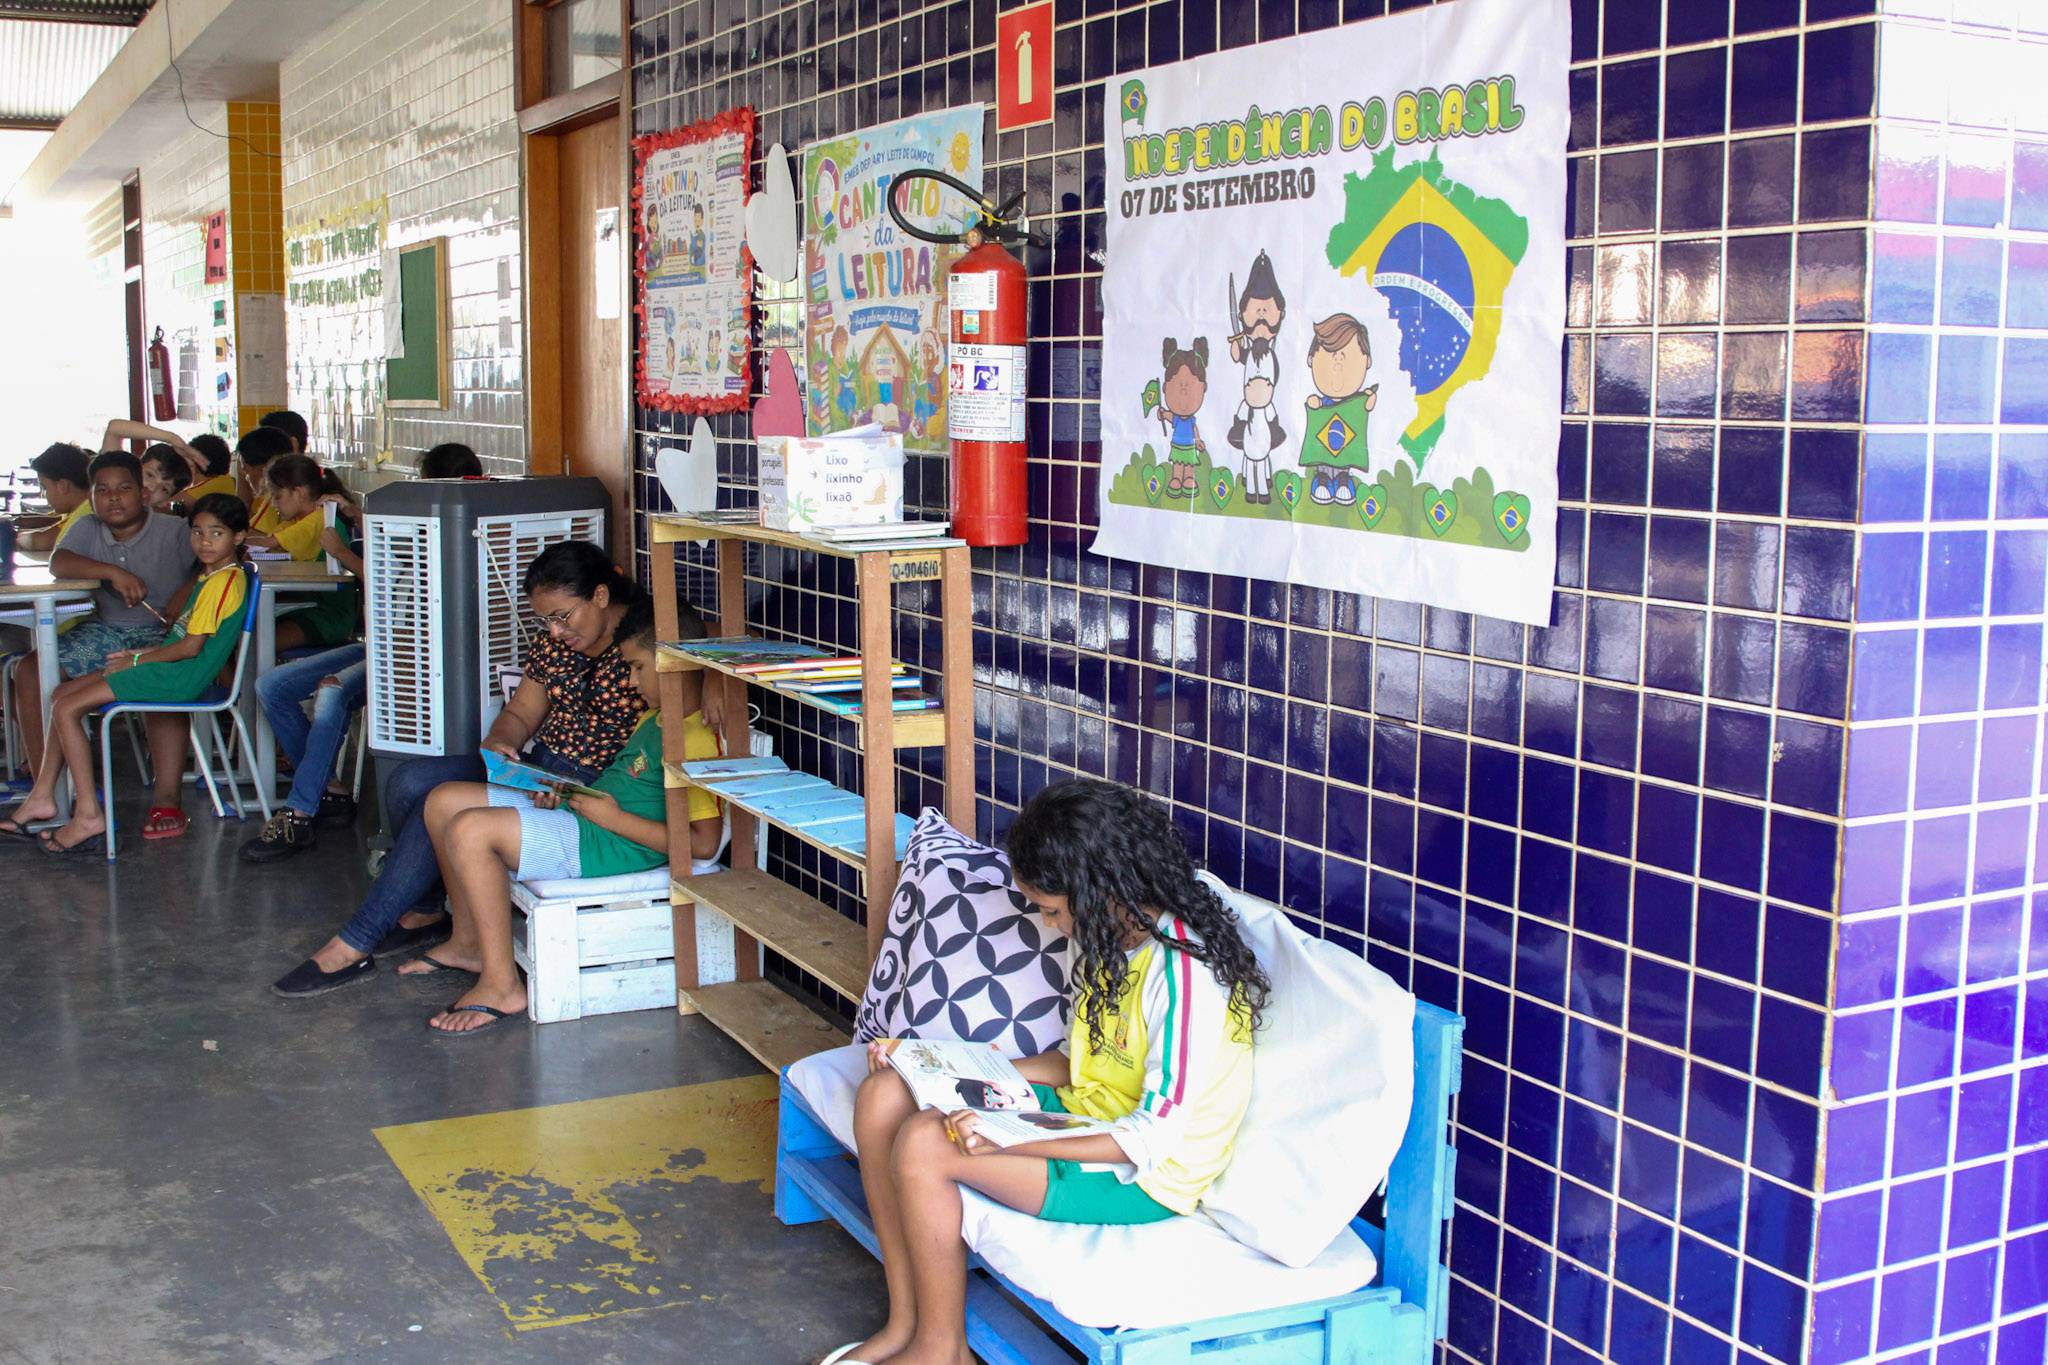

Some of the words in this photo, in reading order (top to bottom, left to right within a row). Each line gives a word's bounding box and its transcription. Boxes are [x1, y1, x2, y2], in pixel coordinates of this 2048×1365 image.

[1125, 104, 1333, 182] INDEPENDÊNCIA
[1340, 96, 1386, 152] DO
[1394, 74, 1525, 146] BRASIL
[656, 168, 698, 200] CANTINHO
[1121, 189, 1145, 218] 07
[1149, 184, 1177, 215] DE
[1183, 167, 1315, 211] SETEMBRO
[669, 194, 696, 213] LEITURA
[839, 174, 940, 229] CANTNHO
[874, 217, 894, 246] da
[838, 247, 932, 300] LEITURA
[1374, 275, 1406, 286] ORDEM
[1417, 280, 1471, 328] PROGRESSO
[971, 347, 983, 356] BC
[826, 455, 848, 465] Lixo
[826, 473, 863, 483] lixinho
